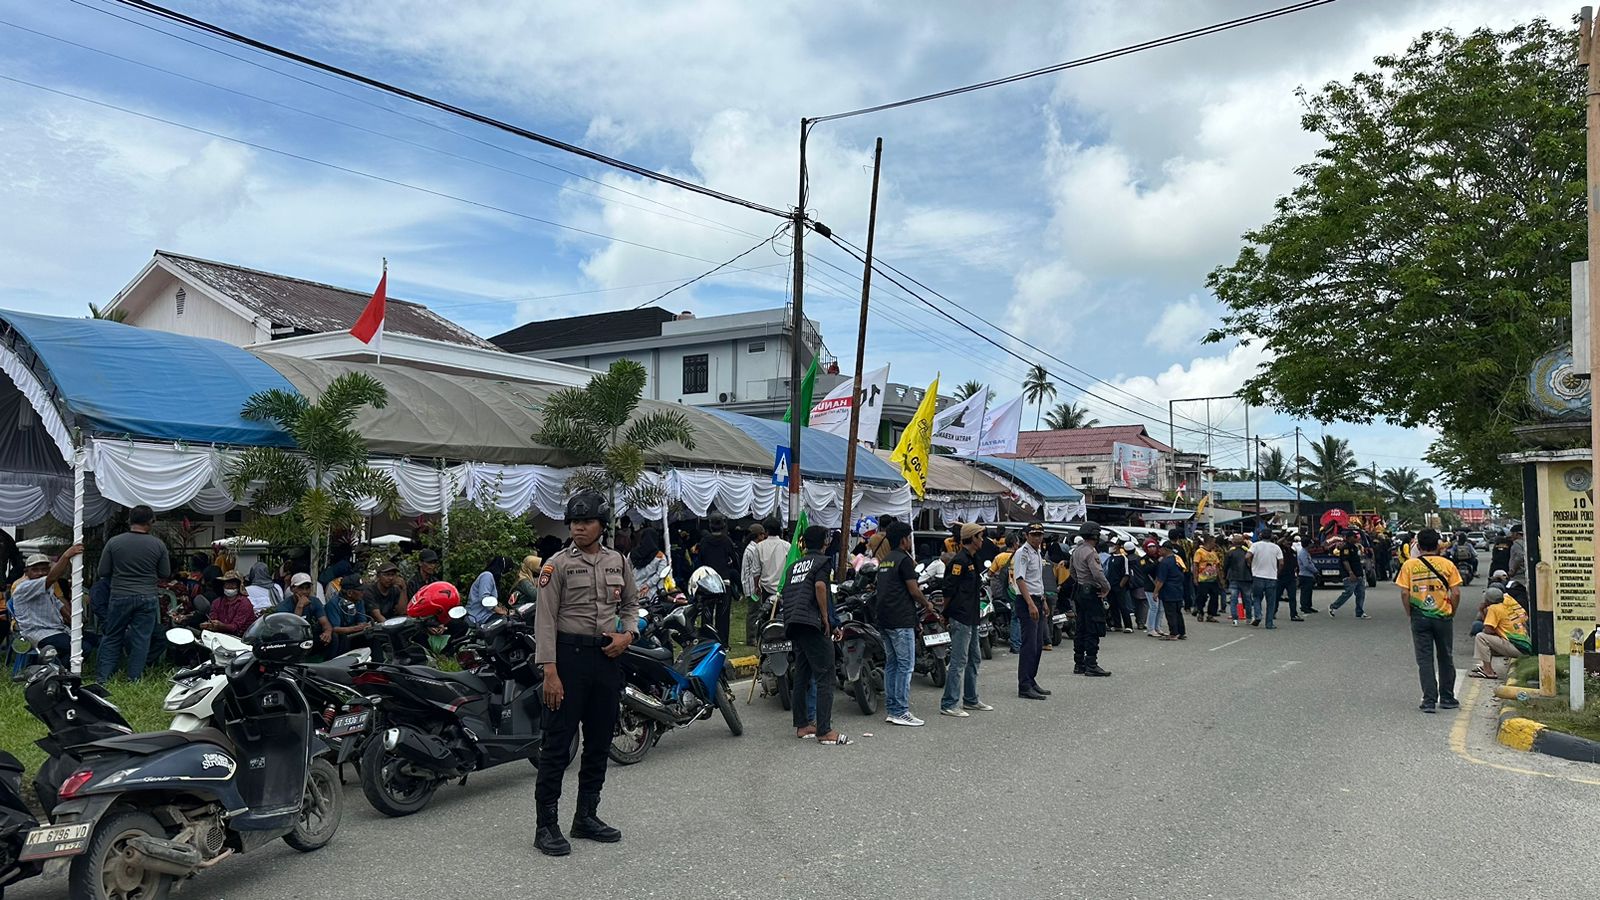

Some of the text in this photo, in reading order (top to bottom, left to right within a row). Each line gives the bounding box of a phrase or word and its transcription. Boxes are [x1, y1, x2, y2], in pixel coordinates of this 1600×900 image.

[1573, 497, 1586, 509] 10
[1553, 510, 1578, 521] PROGRAM
[28, 831, 43, 844] KT
[46, 828, 70, 841] 6796
